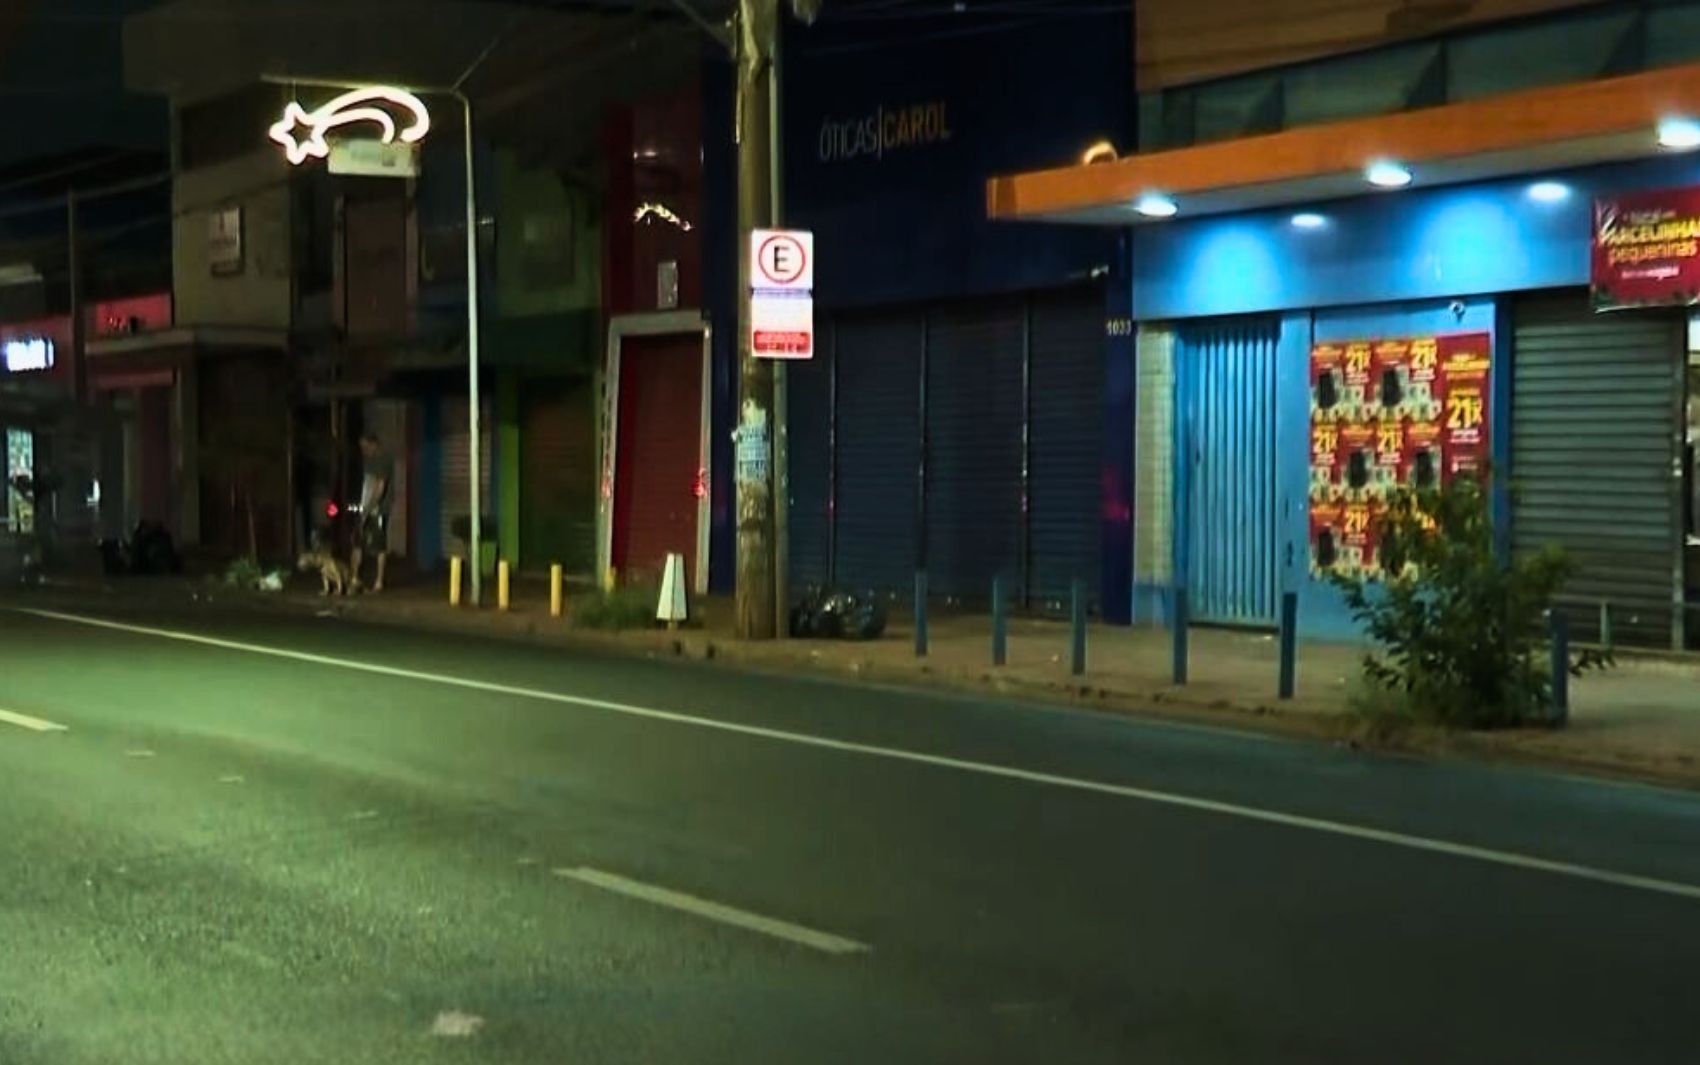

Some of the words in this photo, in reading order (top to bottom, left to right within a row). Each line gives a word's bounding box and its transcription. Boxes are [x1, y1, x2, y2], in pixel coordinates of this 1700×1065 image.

[819, 115, 878, 162] ÓTICAS
[883, 101, 951, 149] CAROL
[773, 245, 789, 272] E
